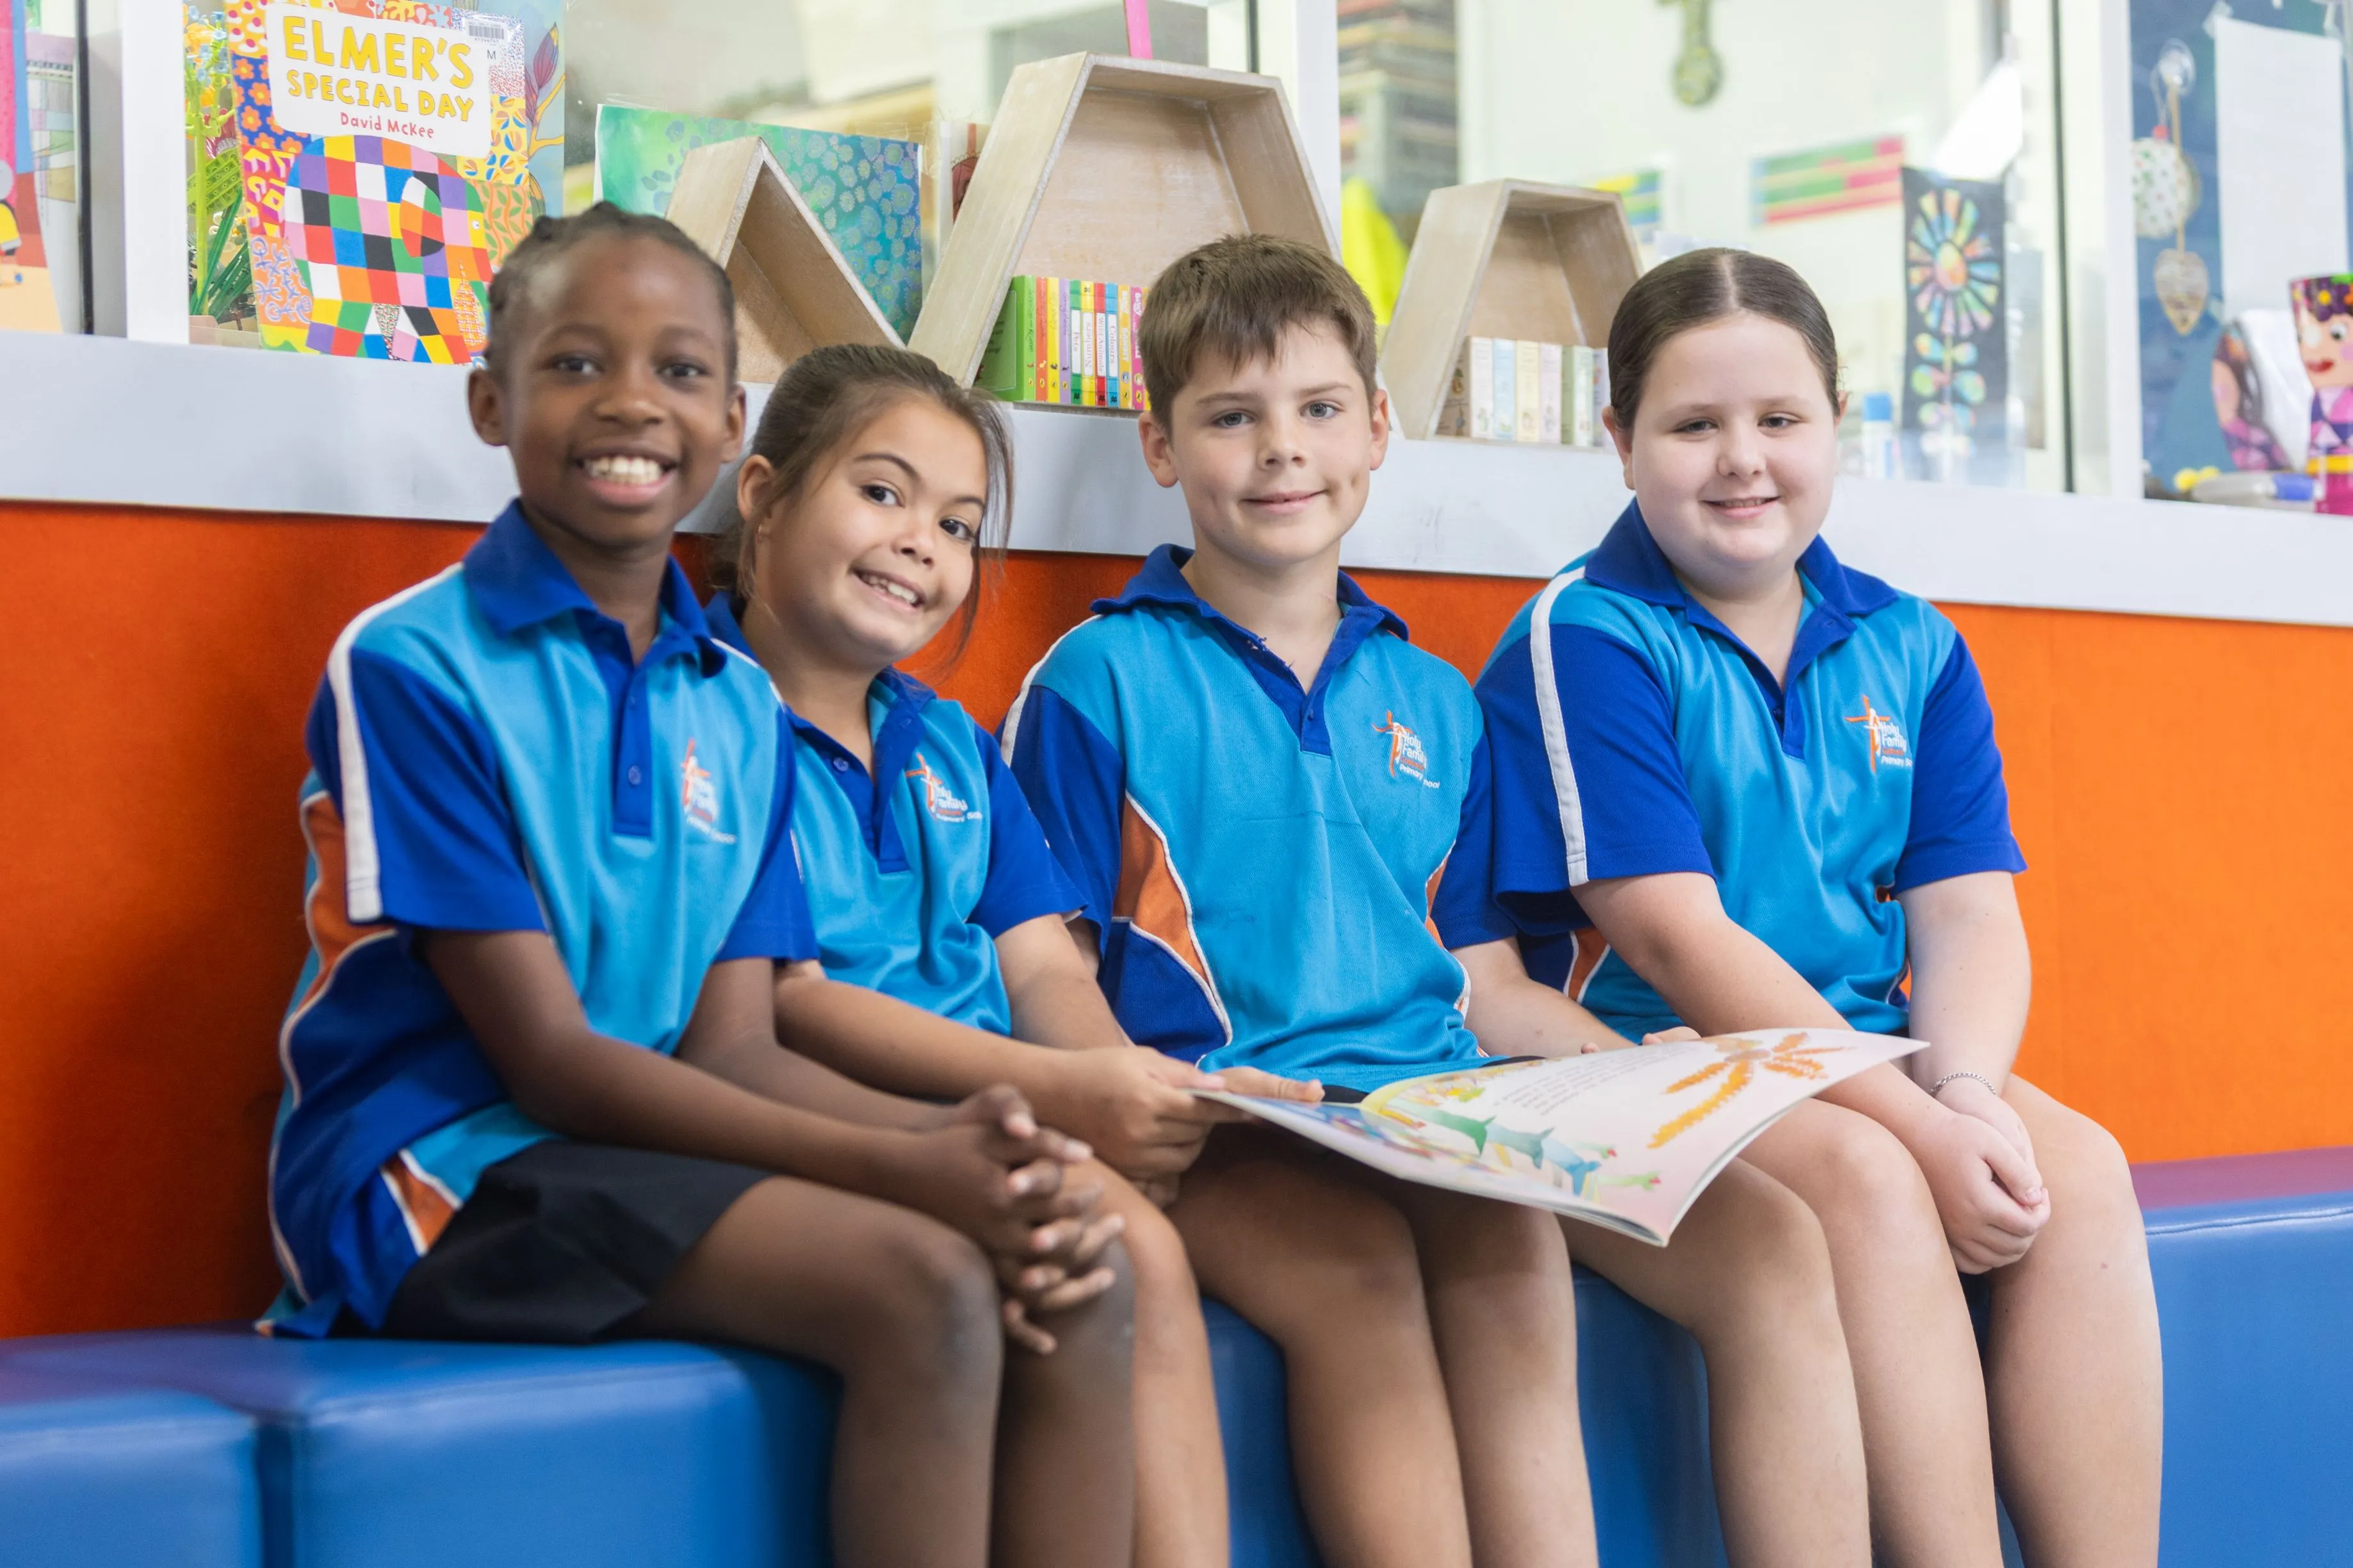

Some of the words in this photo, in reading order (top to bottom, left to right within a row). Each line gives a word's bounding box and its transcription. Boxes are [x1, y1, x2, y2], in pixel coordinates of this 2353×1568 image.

[282, 15, 474, 88] ELMER'S
[287, 69, 409, 112] SPECIAL
[418, 90, 475, 122] DAY
[340, 111, 382, 131] David
[387, 118, 435, 139] McKee
